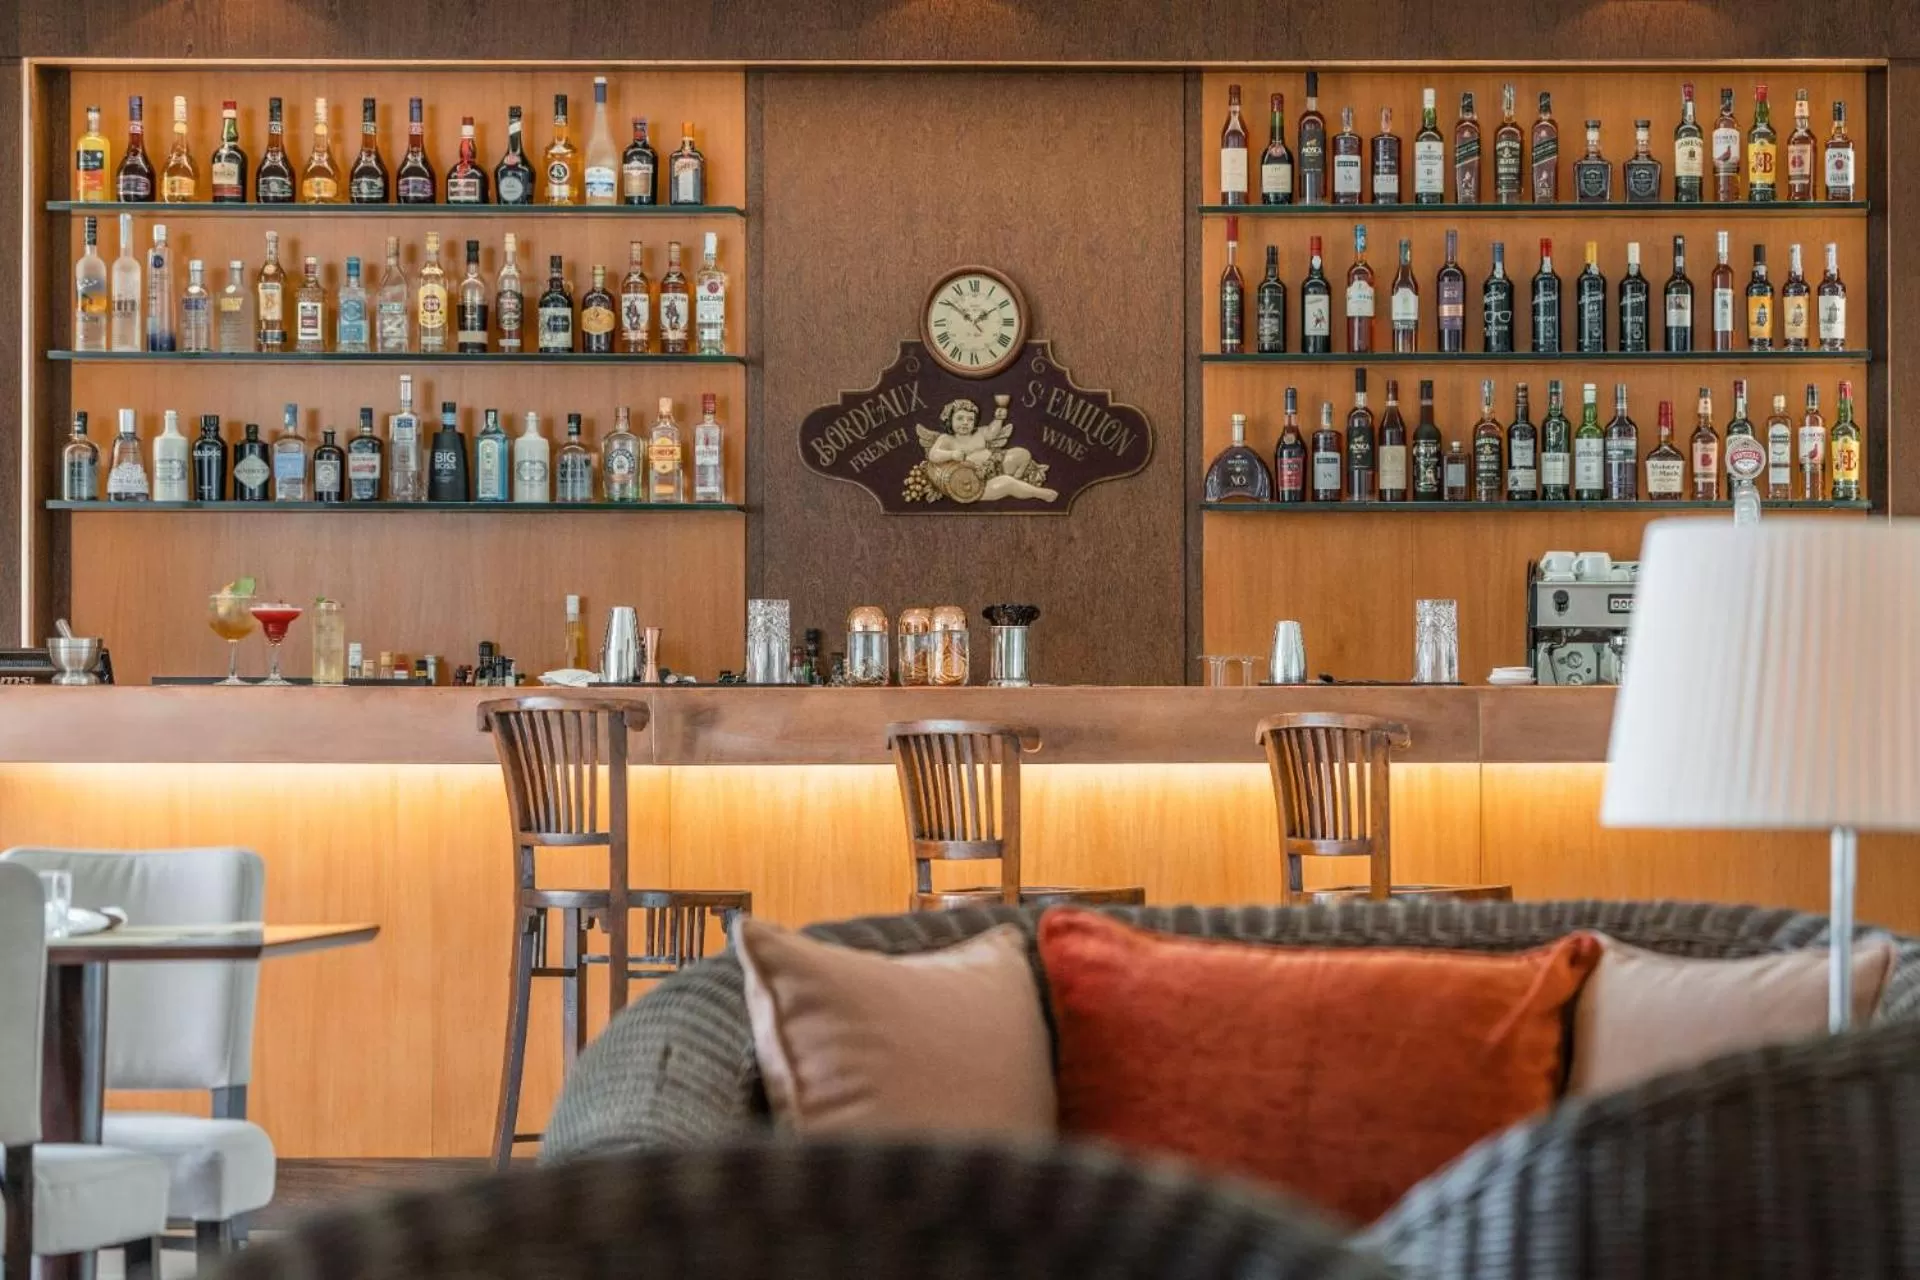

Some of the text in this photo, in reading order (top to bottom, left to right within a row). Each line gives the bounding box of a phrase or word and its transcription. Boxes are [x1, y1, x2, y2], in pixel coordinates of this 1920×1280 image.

[1751, 152, 1773, 173] J&B
[1002, 318, 1014, 326] III
[810, 381, 928, 467] BORDEAUX
[1046, 387, 1138, 457] EMILION
[434, 451, 457, 463] BIG
[848, 428, 910, 473] FRENCH
[1042, 426, 1088, 461] WINE
[435, 462, 457, 470] BOSS
